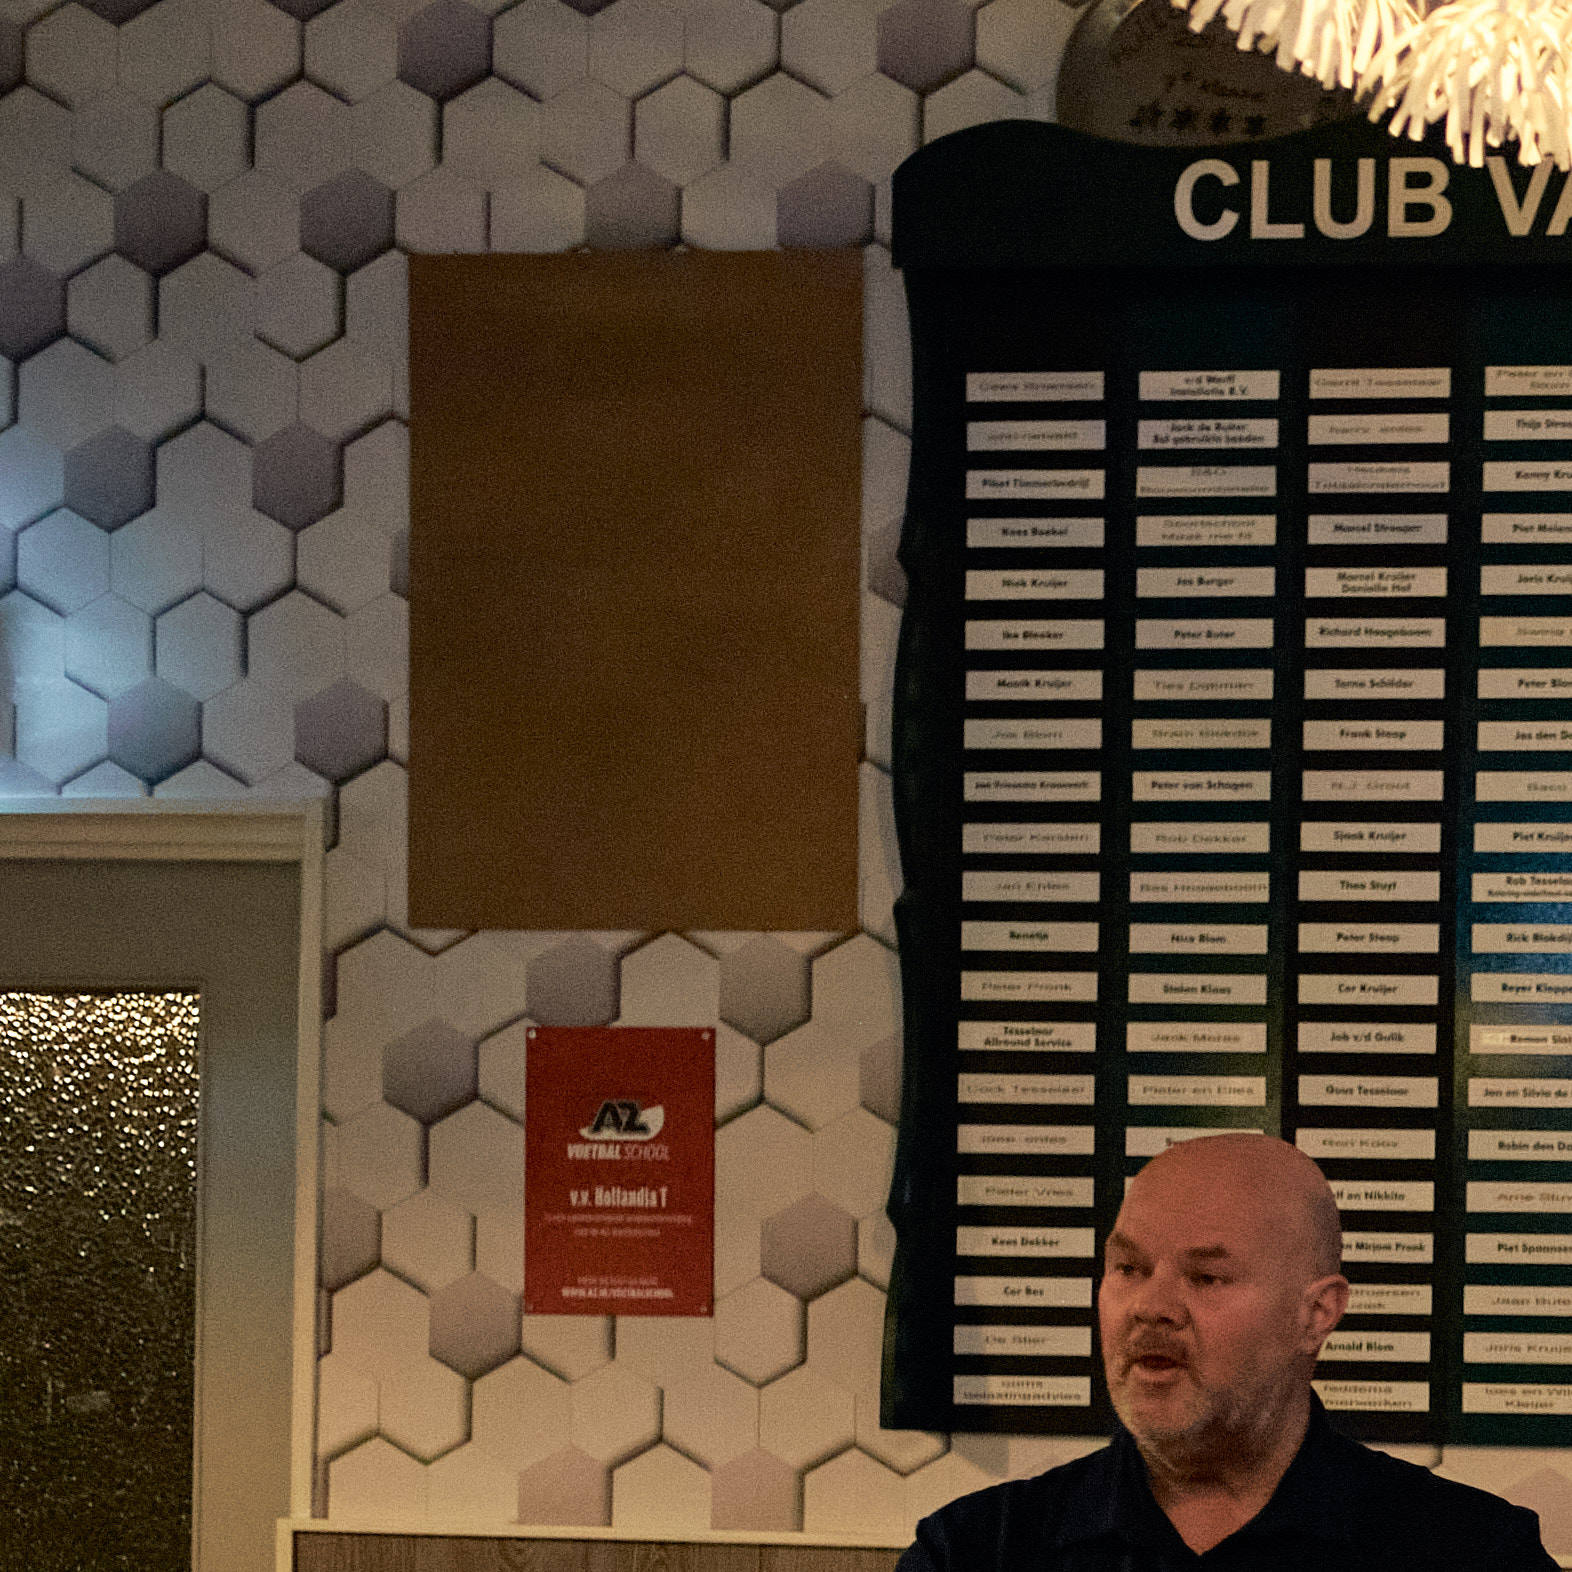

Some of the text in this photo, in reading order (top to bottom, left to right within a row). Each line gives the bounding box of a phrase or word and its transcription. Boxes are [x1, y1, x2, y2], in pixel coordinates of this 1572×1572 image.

[1173, 157, 1455, 241] CLUB
[1197, 576, 1234, 587] Burger
[1174, 630, 1202, 639] Peter
[1518, 679, 1547, 688] Peter
[1535, 731, 1557, 740] den
[1151, 780, 1179, 790] Peter
[1206, 780, 1253, 791] Schagen
[1338, 984, 1356, 993] Cor
[984, 1037, 1071, 1046] Allround Service
[1330, 1032, 1350, 1042] Job
[592, 1100, 650, 1132] AZ
[1533, 1141, 1554, 1151] den
[567, 1143, 670, 1161] VOETBAL SCHOOL
[569, 1185, 668, 1208] v.v. Hollandia T
[1021, 1237, 1060, 1247] Dekker
[1004, 1286, 1022, 1296] Cor
